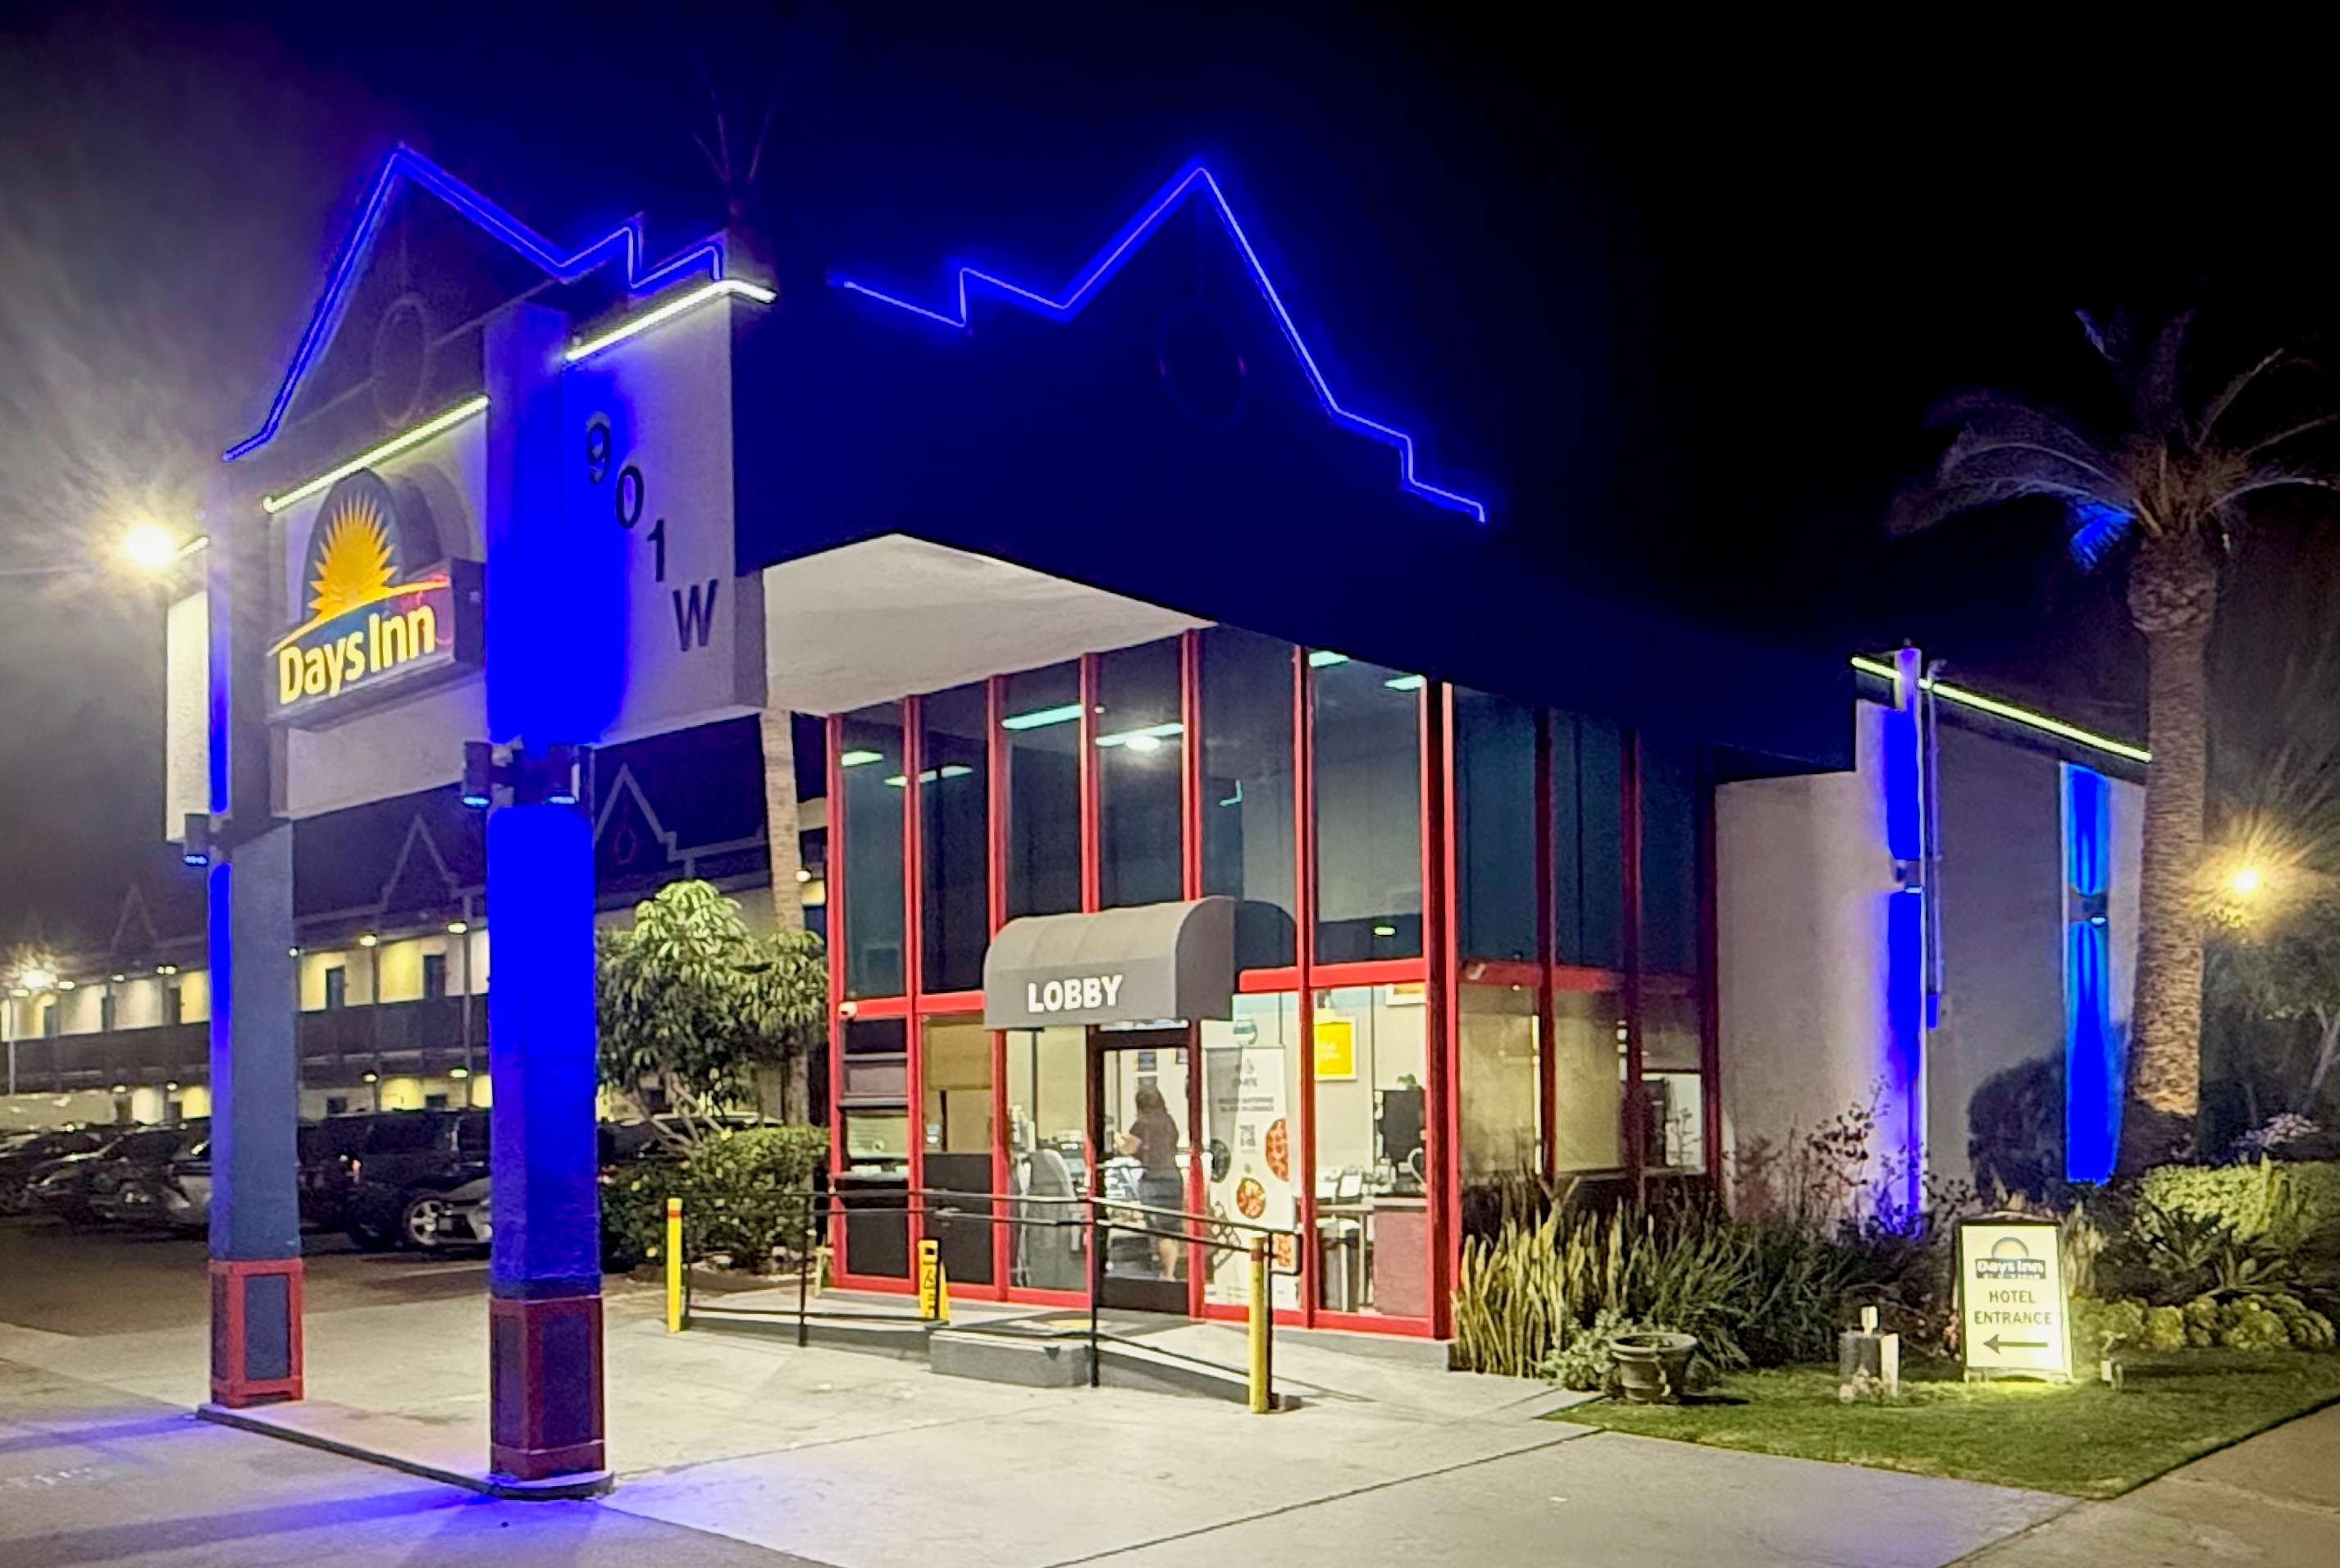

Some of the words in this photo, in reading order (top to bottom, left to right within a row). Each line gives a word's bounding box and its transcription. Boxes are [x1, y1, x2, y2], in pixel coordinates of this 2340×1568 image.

[280, 631, 366, 705] Days
[369, 605, 435, 673] Inn
[1028, 974, 1123, 1013] LOBBY
[1977, 1261, 2015, 1274] Days
[2018, 1260, 2044, 1273] Inn
[1990, 1291, 2036, 1303] HOTEL
[1974, 1311, 2051, 1324] ENTRANCE
